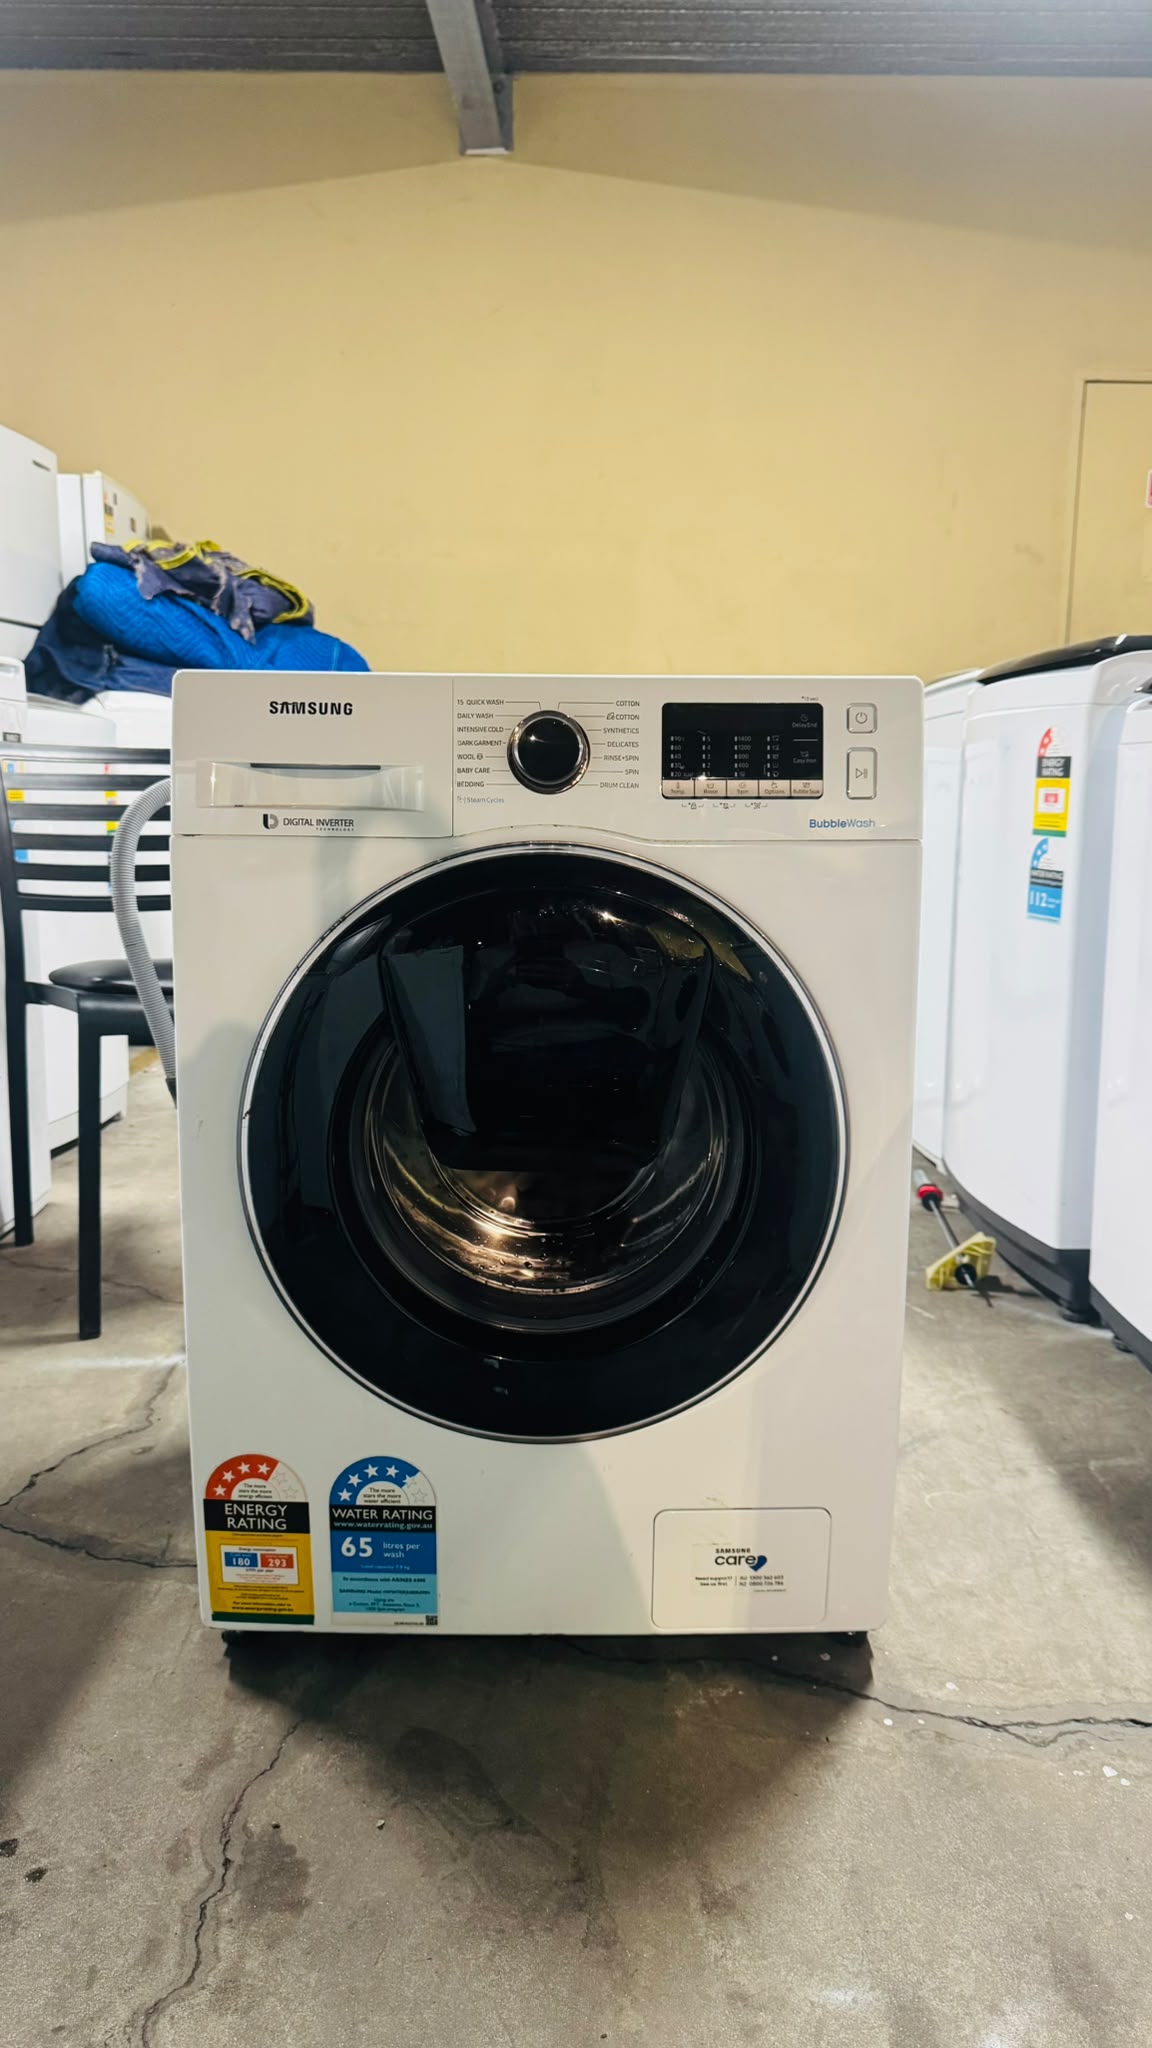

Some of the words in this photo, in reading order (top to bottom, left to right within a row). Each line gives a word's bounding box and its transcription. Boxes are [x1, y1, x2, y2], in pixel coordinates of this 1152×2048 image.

[269, 701, 353, 715] SAMSUNG
[283, 818, 314, 826] DIGITAL
[316, 819, 354, 827] INVERTER
[809, 818, 876, 828] BubbleWash
[224, 1503, 288, 1516] ENERGY
[332, 1508, 378, 1520] WATER
[382, 1510, 432, 1520] RATING
[227, 1517, 288, 1530] RATING
[334, 1521, 432, 1530] www.waterrating.gov.au
[341, 1536, 373, 1558] 65
[232, 1558, 250, 1566] 180
[268, 1558, 287, 1568] 293
[714, 1555, 756, 1566] care
